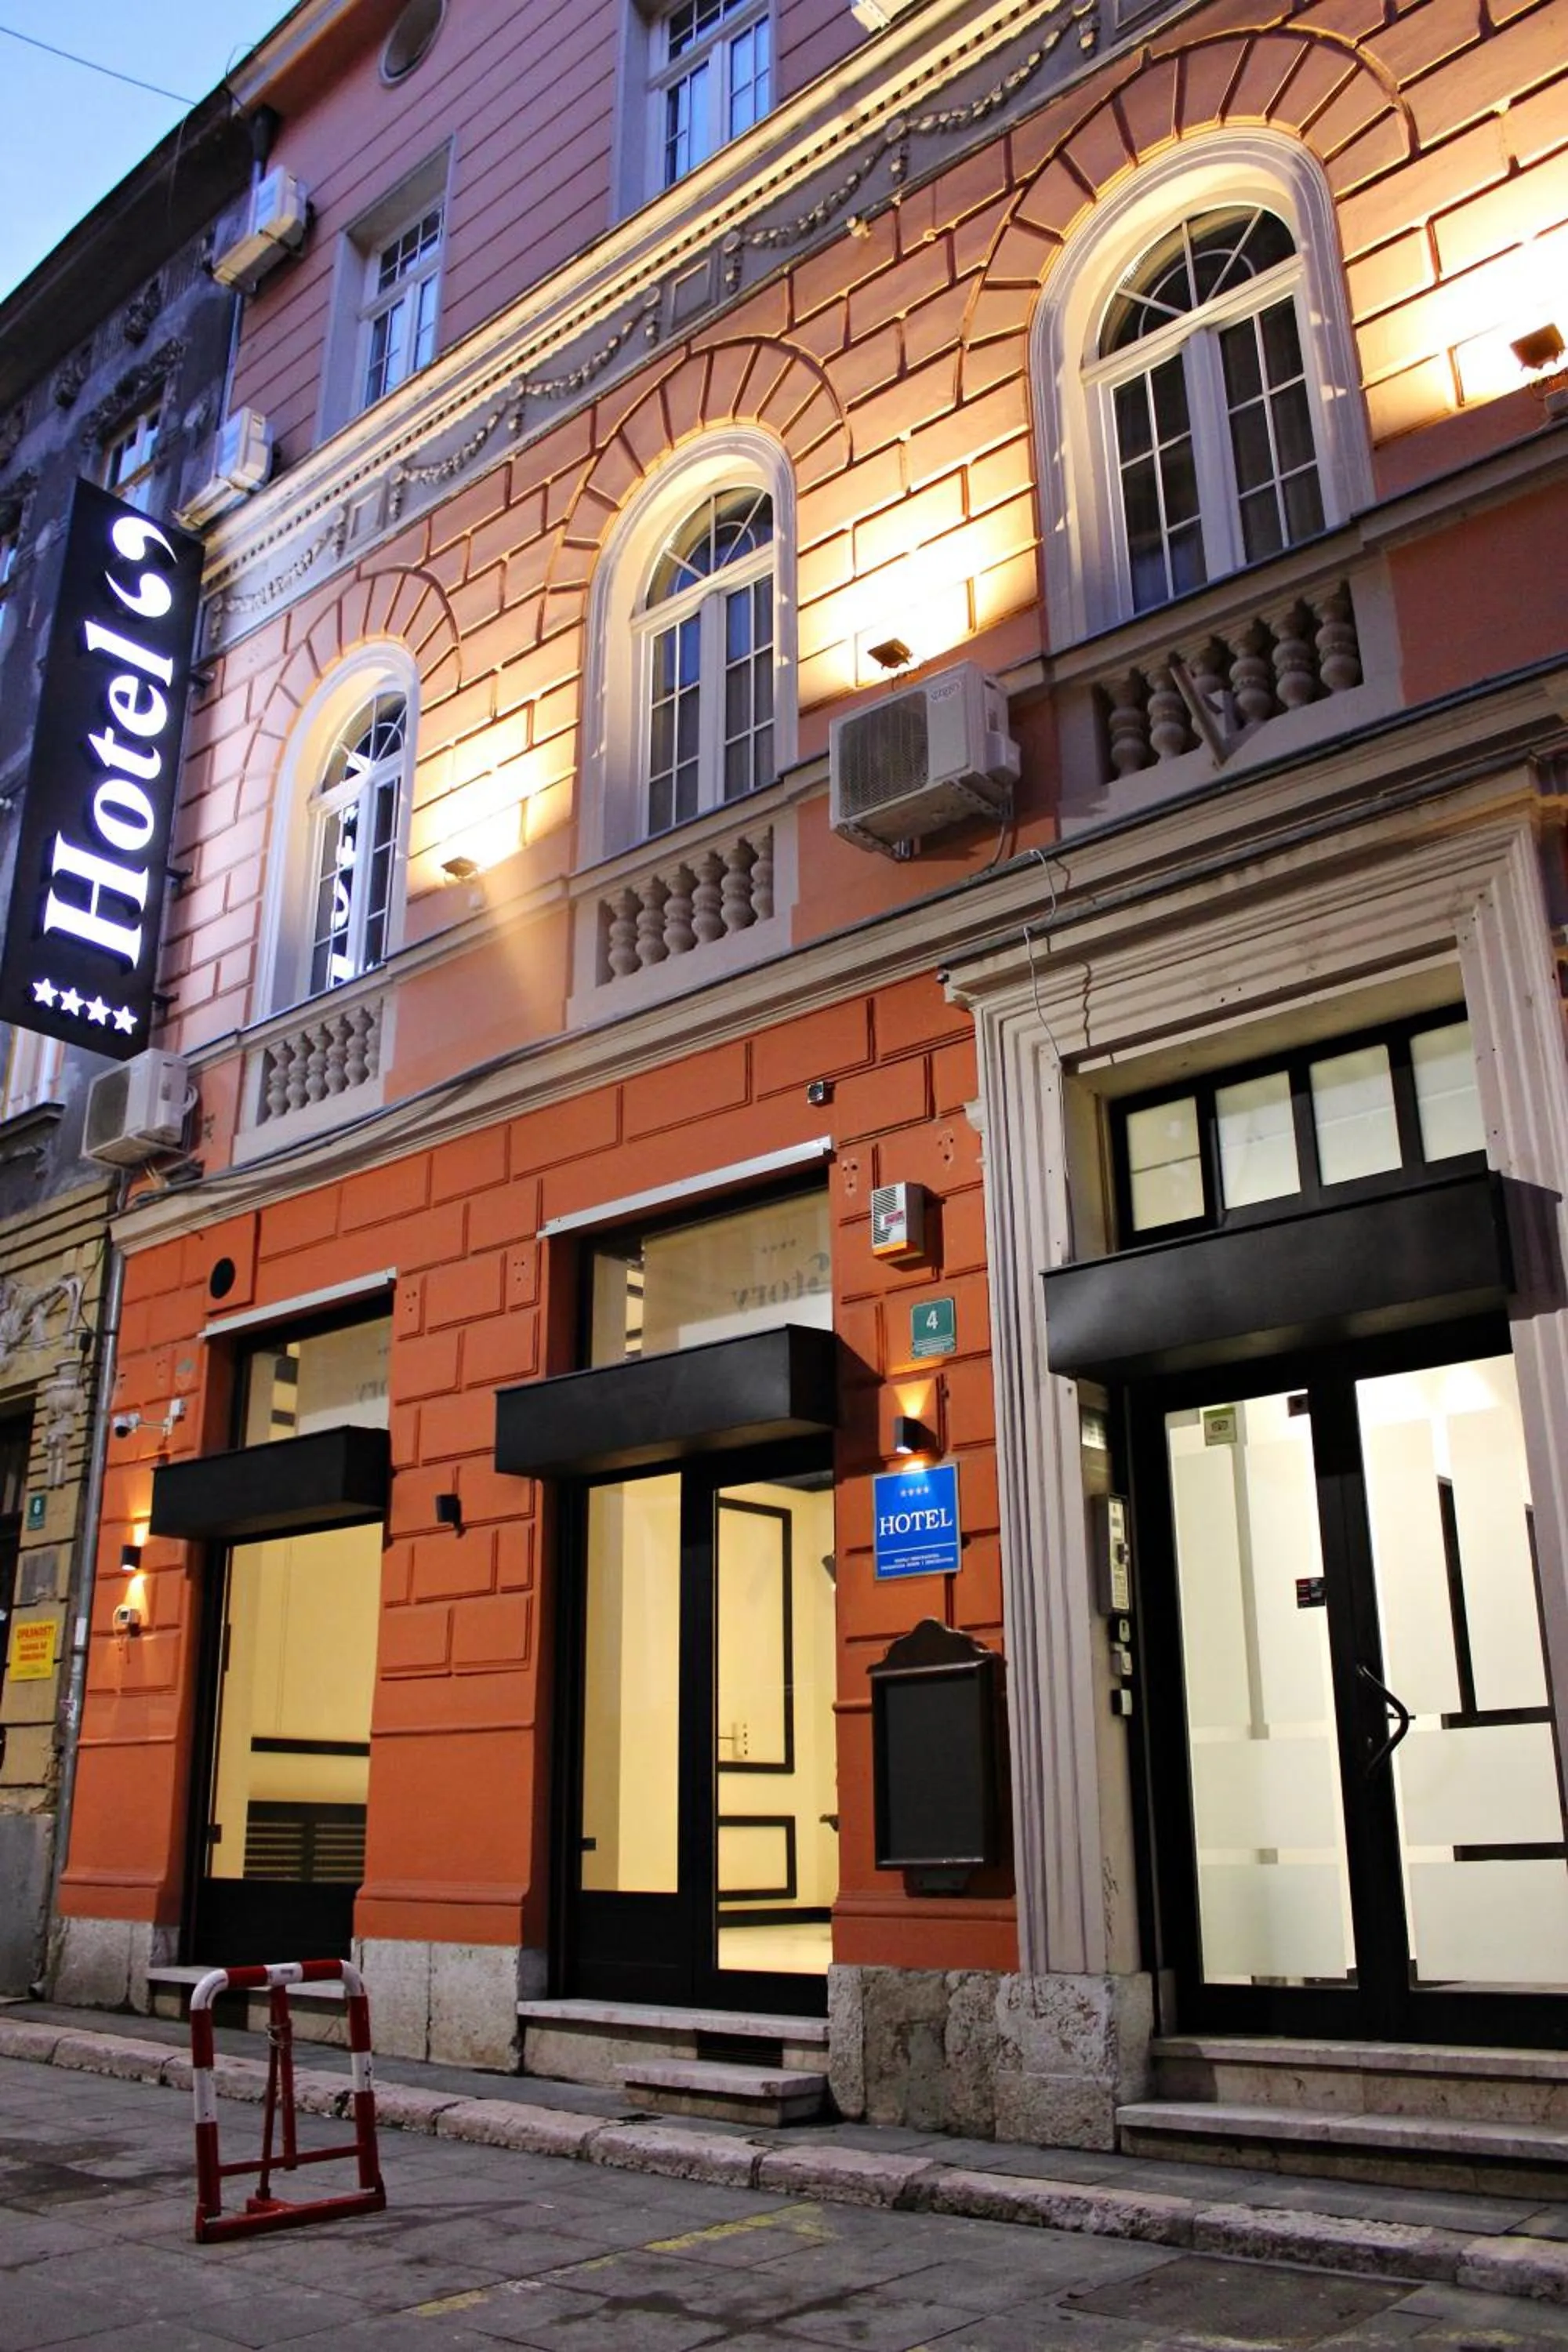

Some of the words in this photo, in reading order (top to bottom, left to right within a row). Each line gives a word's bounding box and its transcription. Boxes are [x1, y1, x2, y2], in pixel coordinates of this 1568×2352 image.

[42, 619, 173, 970] Hotel
[926, 1309, 938, 1330] 4
[879, 1508, 953, 1537] HOTEL
